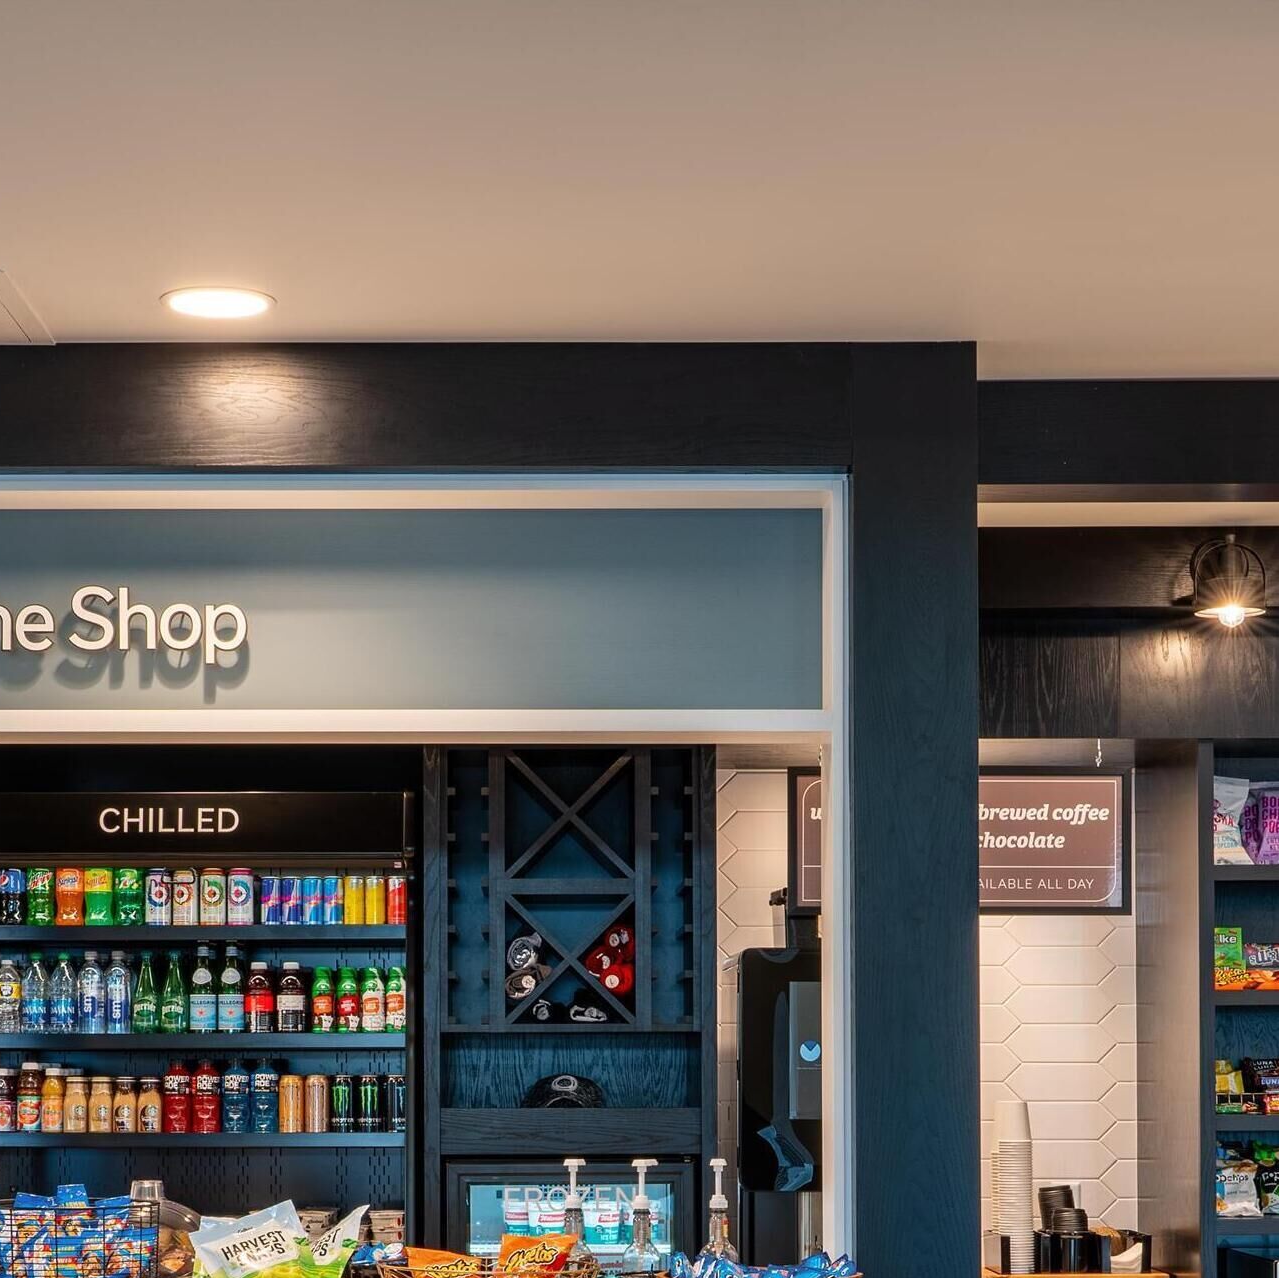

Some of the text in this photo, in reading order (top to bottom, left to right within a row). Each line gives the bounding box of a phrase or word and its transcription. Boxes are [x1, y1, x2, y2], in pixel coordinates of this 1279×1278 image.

[68, 585, 248, 665] Shop
[99, 807, 239, 833] CHILLED
[978, 804, 1110, 826] brewed coffee
[1037, 878, 1063, 890] ALL
[1067, 878, 1095, 890] DAY
[221, 1230, 286, 1260] HARVEST
